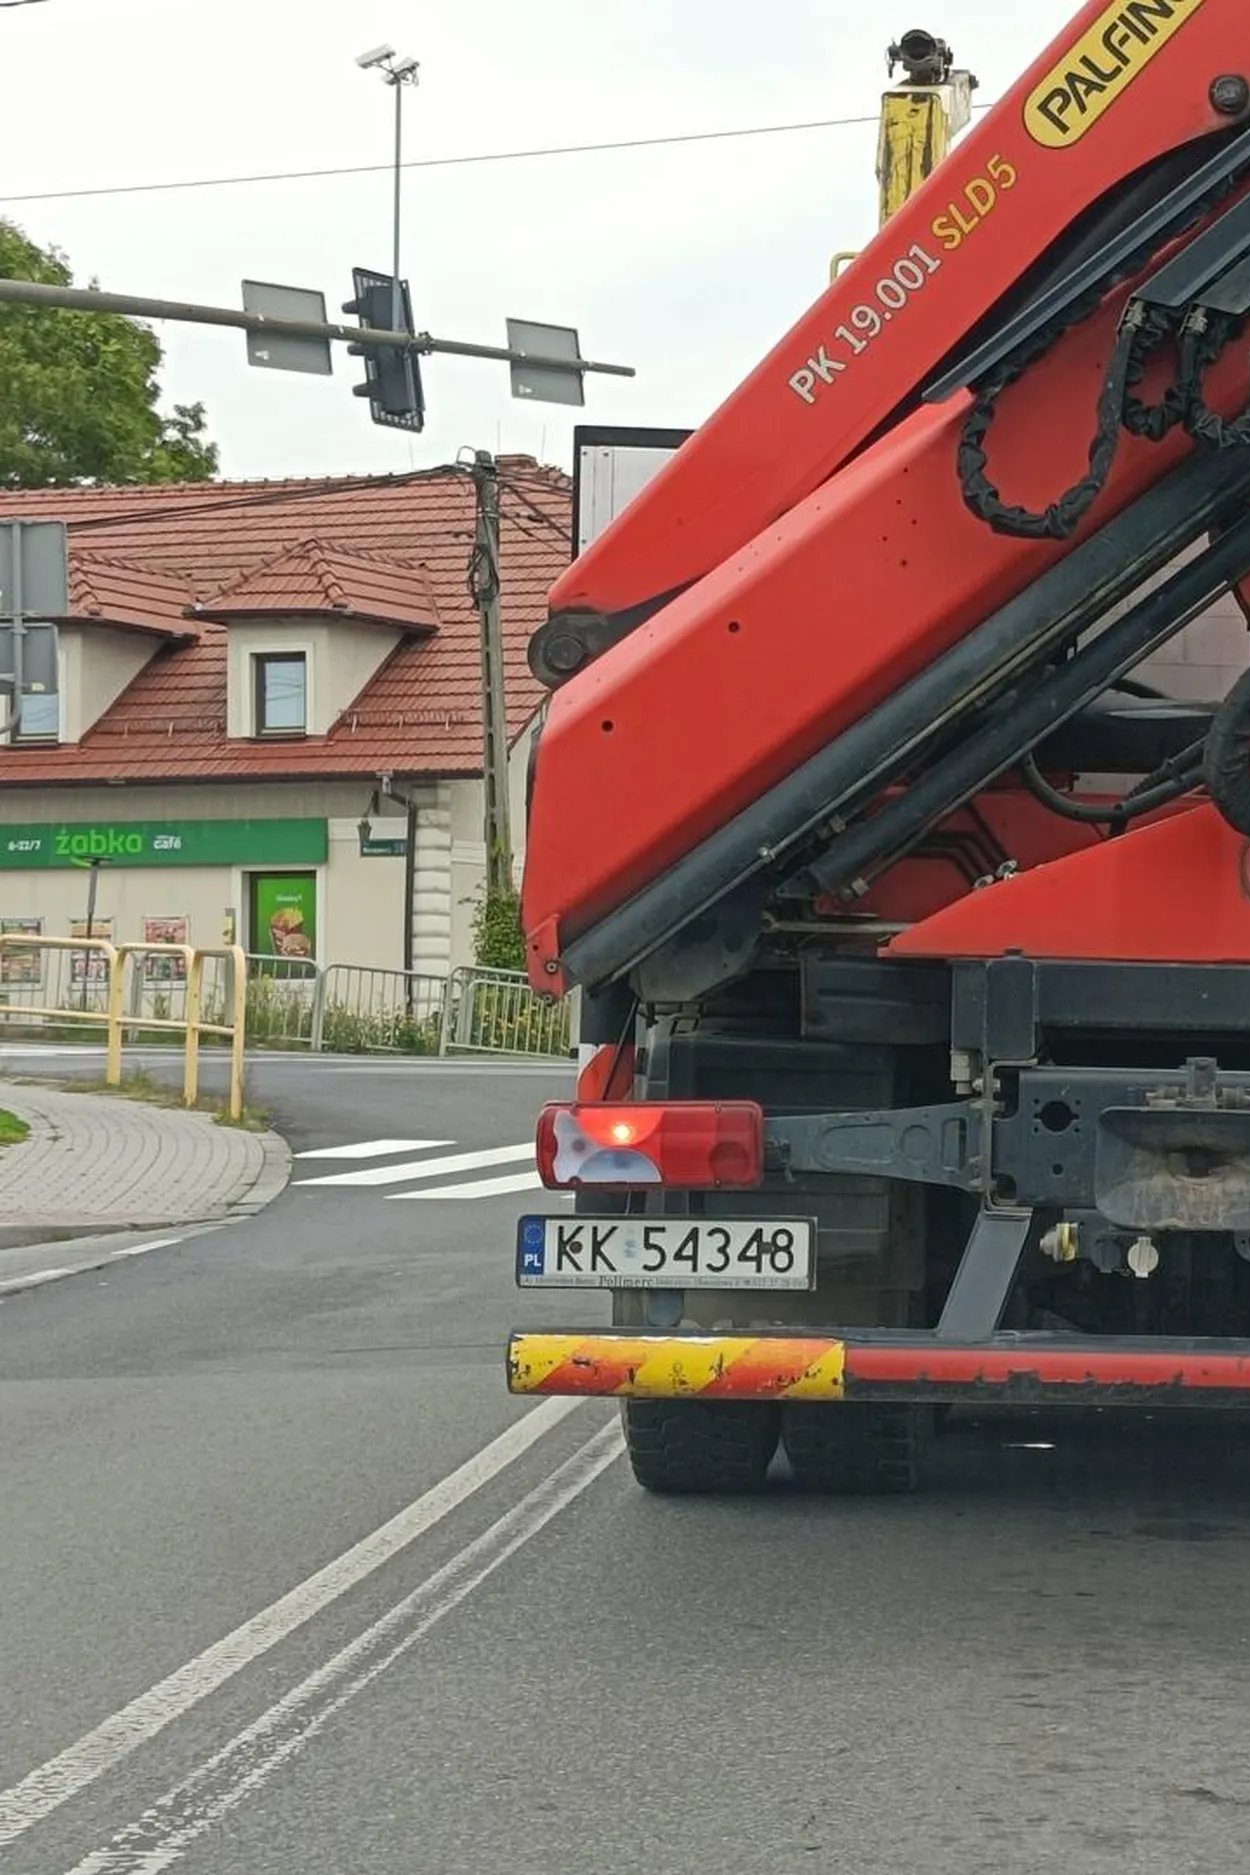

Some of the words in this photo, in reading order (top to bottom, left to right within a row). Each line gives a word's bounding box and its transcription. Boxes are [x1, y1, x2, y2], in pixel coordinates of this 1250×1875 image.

[1037, 0, 1183, 135] PALFIN
[789, 346, 845, 403] PK
[835, 244, 941, 356] 19.001
[55, 828, 142, 855] żabka
[524, 1254, 542, 1267] PL
[642, 1226, 795, 1273] 54348
